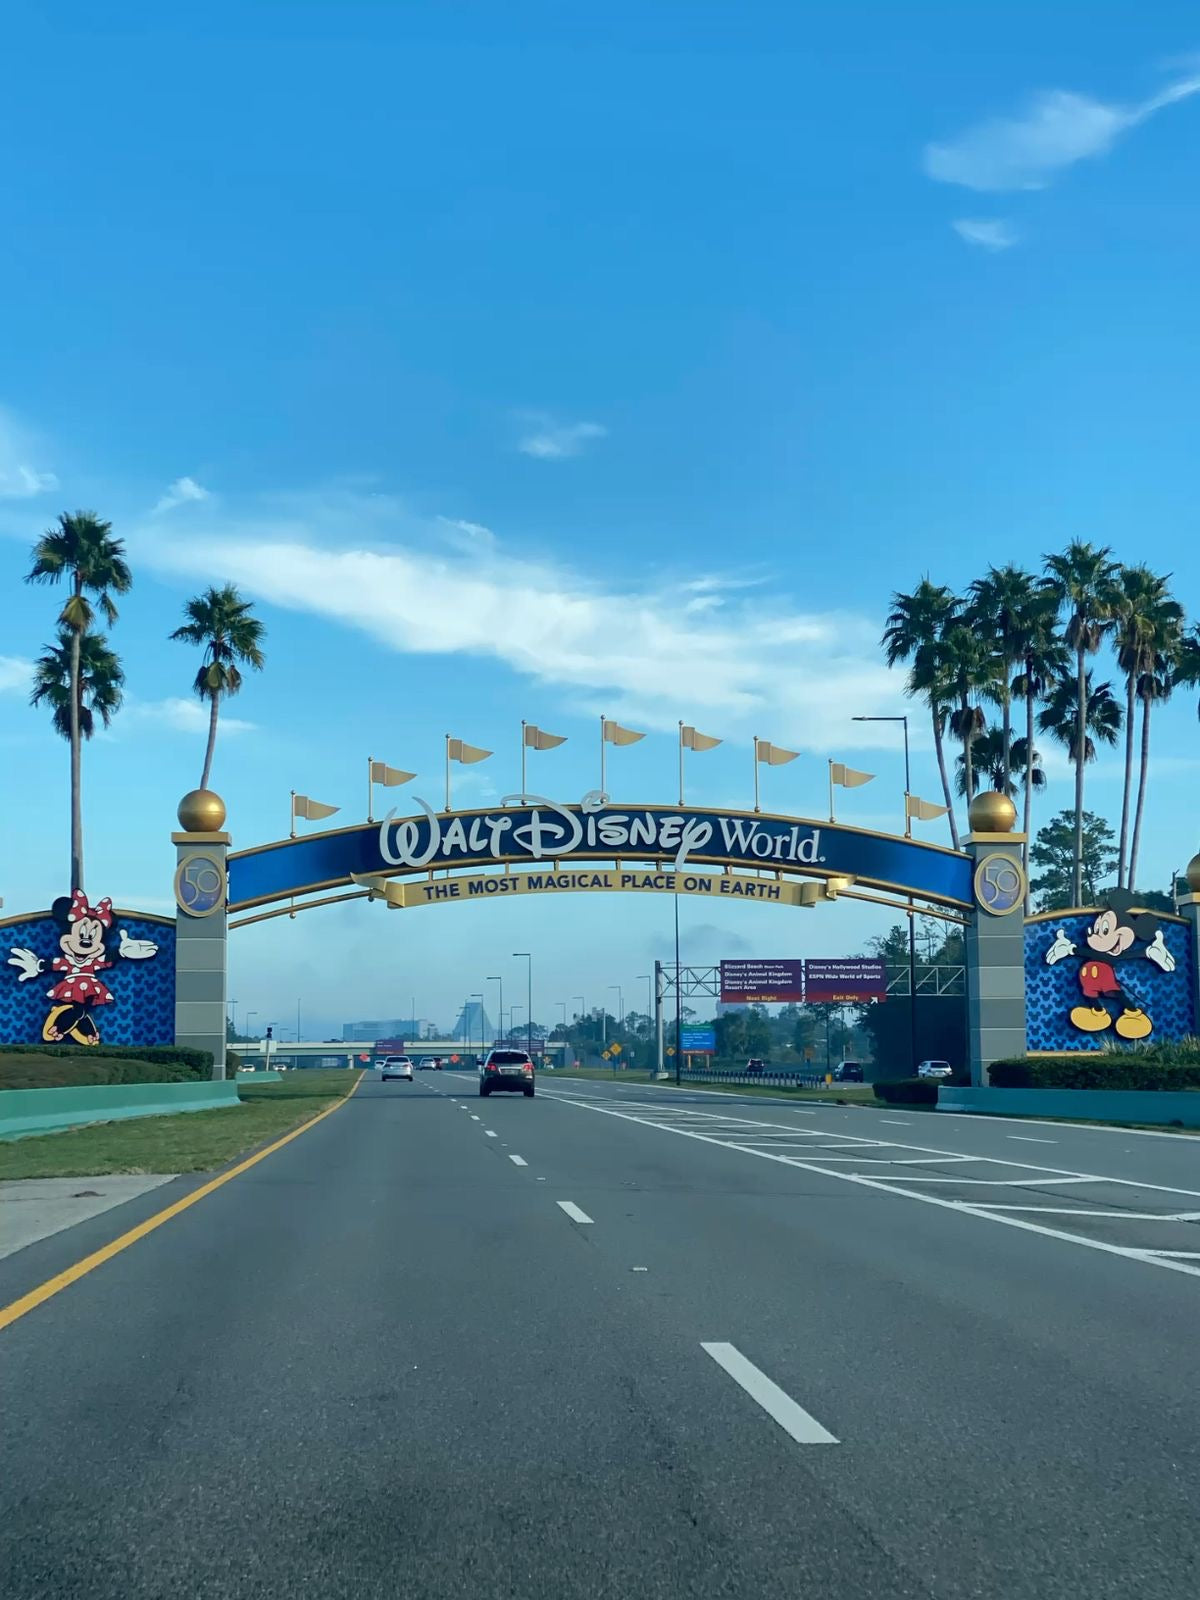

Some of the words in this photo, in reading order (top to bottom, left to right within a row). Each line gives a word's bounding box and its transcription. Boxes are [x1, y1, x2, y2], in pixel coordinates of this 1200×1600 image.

[185, 866, 221, 906] 50
[423, 882, 460, 900] THE
[468, 876, 520, 895] MOST
[527, 872, 613, 890] MAGICAL
[621, 874, 676, 890] PLACE
[683, 876, 712, 892] ON
[719, 879, 781, 900] EARTH
[985, 866, 1020, 905] 50
